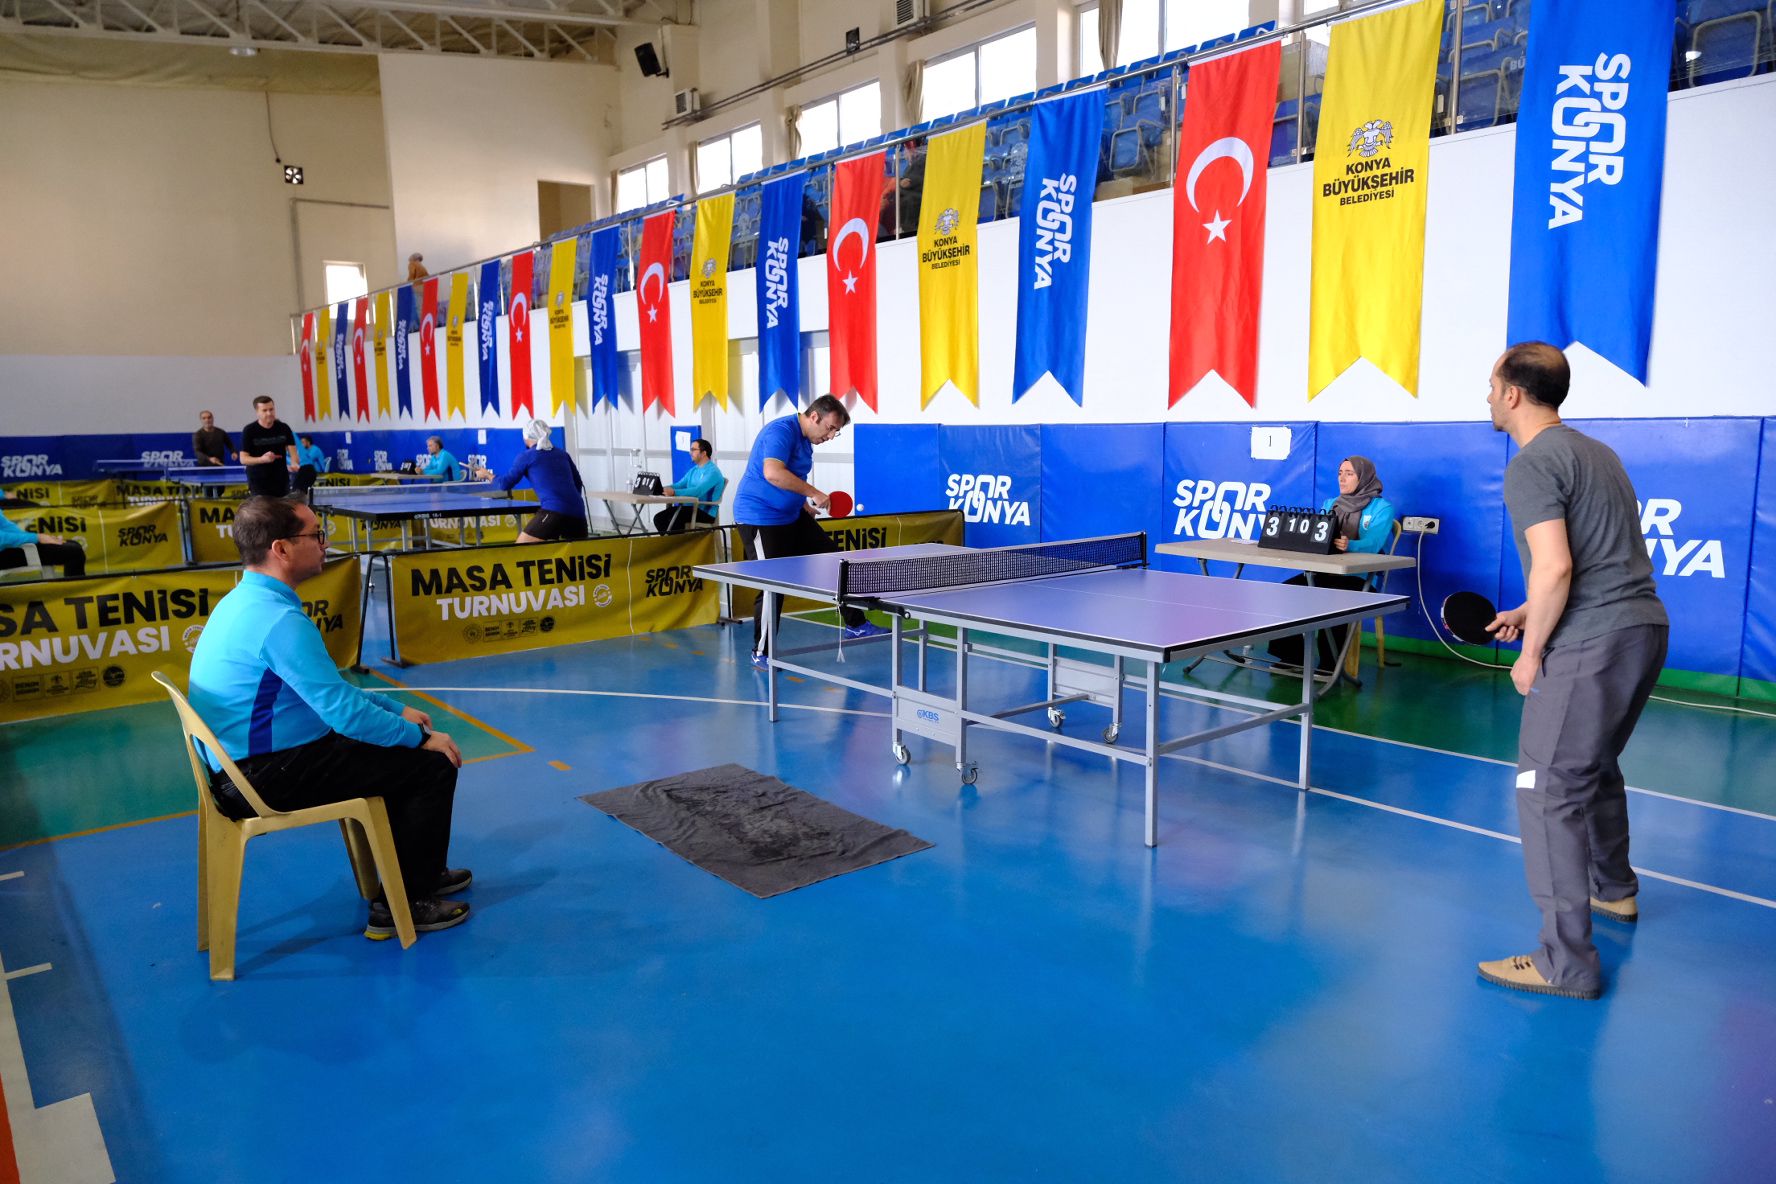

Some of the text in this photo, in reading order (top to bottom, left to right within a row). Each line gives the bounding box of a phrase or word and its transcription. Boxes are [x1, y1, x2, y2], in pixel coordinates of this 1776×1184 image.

[1578, 52, 1631, 186] SPOR
[1548, 65, 1602, 229] KONYA
[1346, 157, 1391, 175] KONYA
[1323, 167, 1415, 197] BÜYÜKŞEHİR
[1340, 187, 1394, 206] BELEDİYESİ
[1049, 173, 1077, 263] SPOR
[934, 236, 958, 248] KONYA
[1034, 178, 1060, 289] KONYA
[765, 240, 780, 328] KONYA
[773, 236, 789, 308] SPOR
[1, 454, 48, 468] SPOR
[3, 463, 63, 477] KONYA
[945, 473, 1012, 499] SPOR
[1172, 479, 1272, 513] SPOR
[948, 492, 1031, 526] KONYA
[118, 525, 157, 539] SPOR
[119, 533, 168, 547] KONYA
[1266, 516, 1329, 542] 3 1 0 3
[411, 563, 512, 597] MASA
[645, 565, 691, 583] SPOR
[646, 577, 704, 598] KONYA
[436, 585, 585, 621] TURNUVASI
